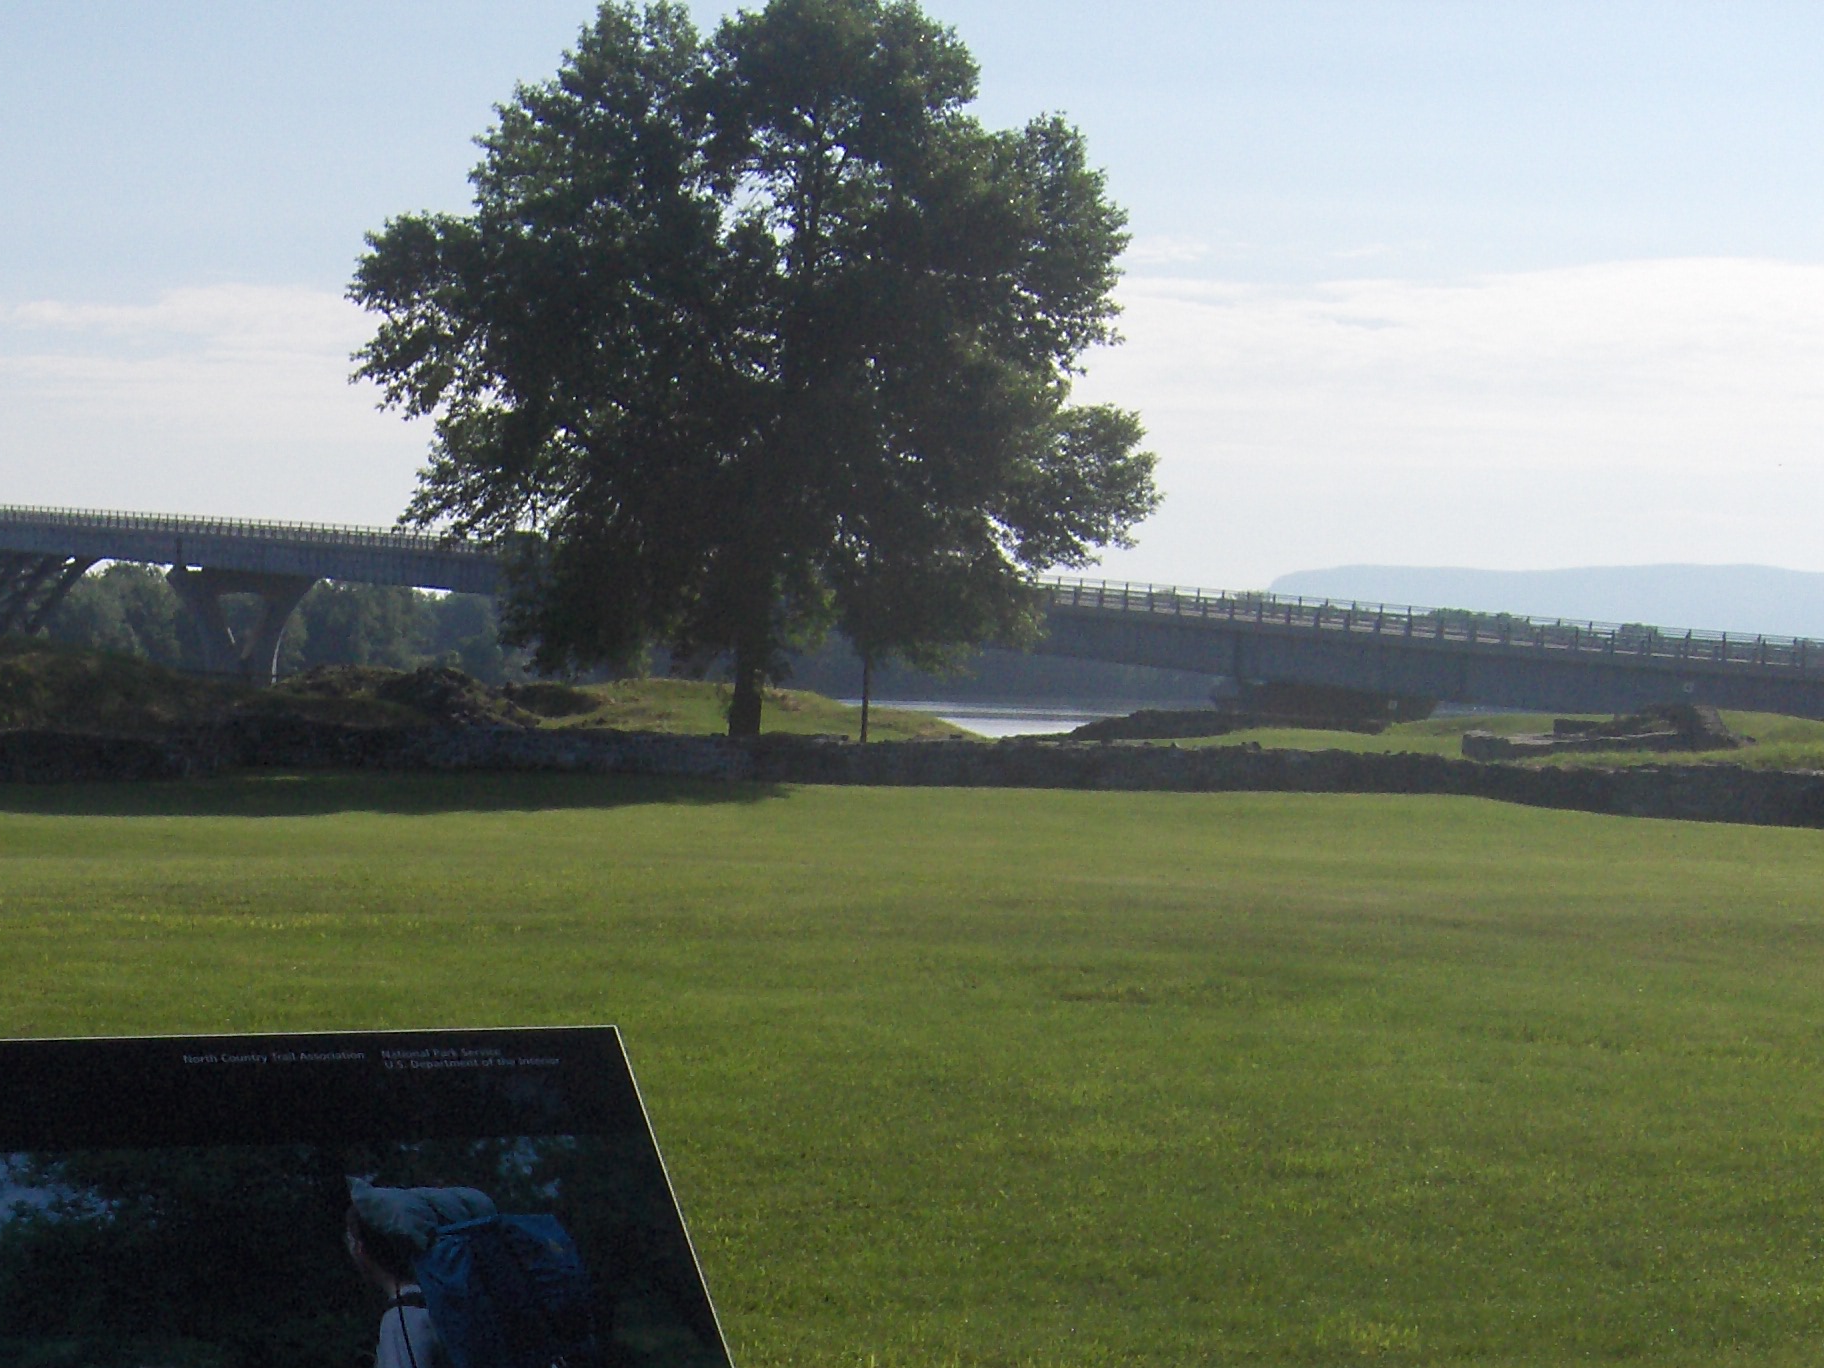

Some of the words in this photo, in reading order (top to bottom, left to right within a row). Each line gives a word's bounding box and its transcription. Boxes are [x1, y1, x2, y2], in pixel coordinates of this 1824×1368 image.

[183, 1054, 216, 1064] North
[221, 1053, 267, 1064] Country
[272, 1051, 296, 1061] Trail
[300, 1050, 364, 1060] Association
[381, 1048, 429, 1059] National
[433, 1048, 457, 1058] Park
[461, 1047, 501, 1057] Service
[410, 1058, 478, 1070] Department
[482, 1057, 494, 1067] of
[497, 1056, 516, 1066] the
[518, 1056, 560, 1066] Interior
